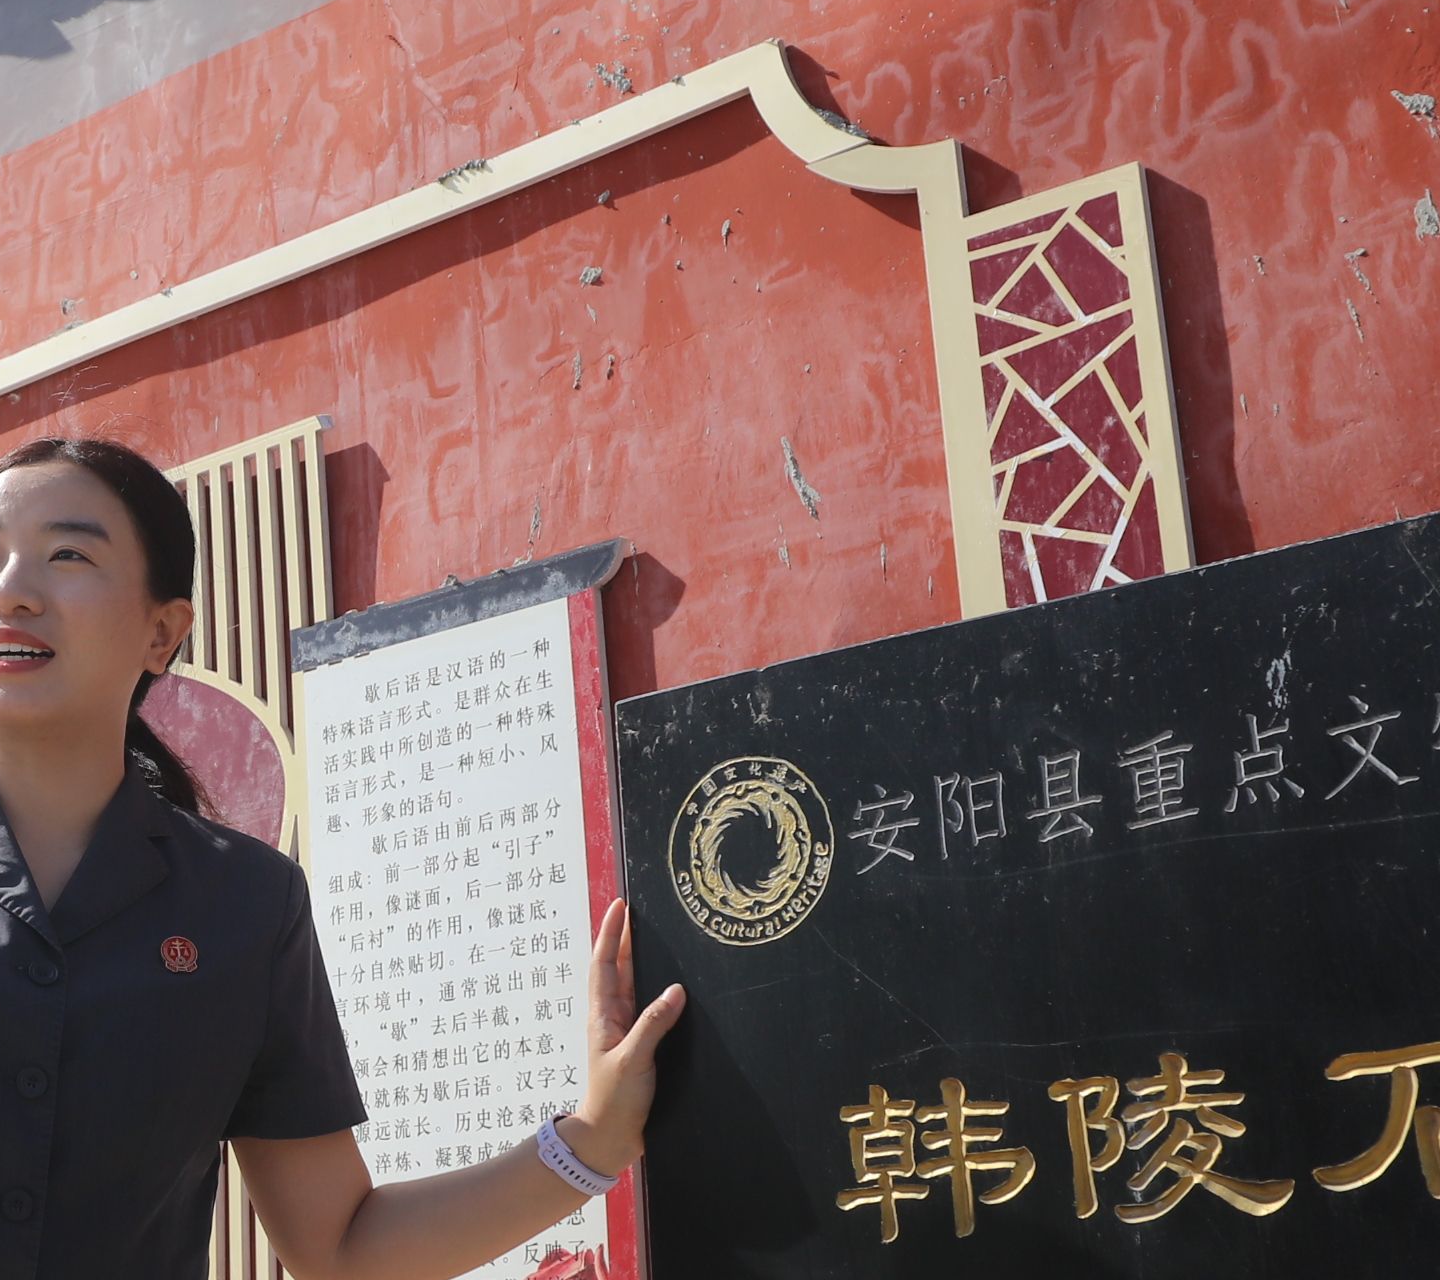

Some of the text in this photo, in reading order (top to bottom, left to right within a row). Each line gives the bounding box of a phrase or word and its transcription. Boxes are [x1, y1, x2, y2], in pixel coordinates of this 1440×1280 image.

[364, 638, 550, 703] 歇后语是汉语的一种
[322, 670, 554, 744] 特殊语言形式。是群众在生
[323, 701, 556, 775] 活实践中所创造的一种特殊
[325, 733, 558, 805] 语言形式，是一种短小、风
[326, 789, 464, 834] 趣、形象的语句。
[371, 797, 562, 855] 歇后语由前后两部分
[329, 863, 568, 926] 作用，像谜面，后一部分起
[332, 928, 571, 988] 十分自然贴切。在一定的语
[335, 962, 574, 1019] 言环境中，通常说出前半
[354, 1032, 567, 1080] 领会和猜想出它的本意，
[375, 1140, 522, 1175] 淬炼、凝聚成
[482, 1240, 586, 1267] 。反映了
